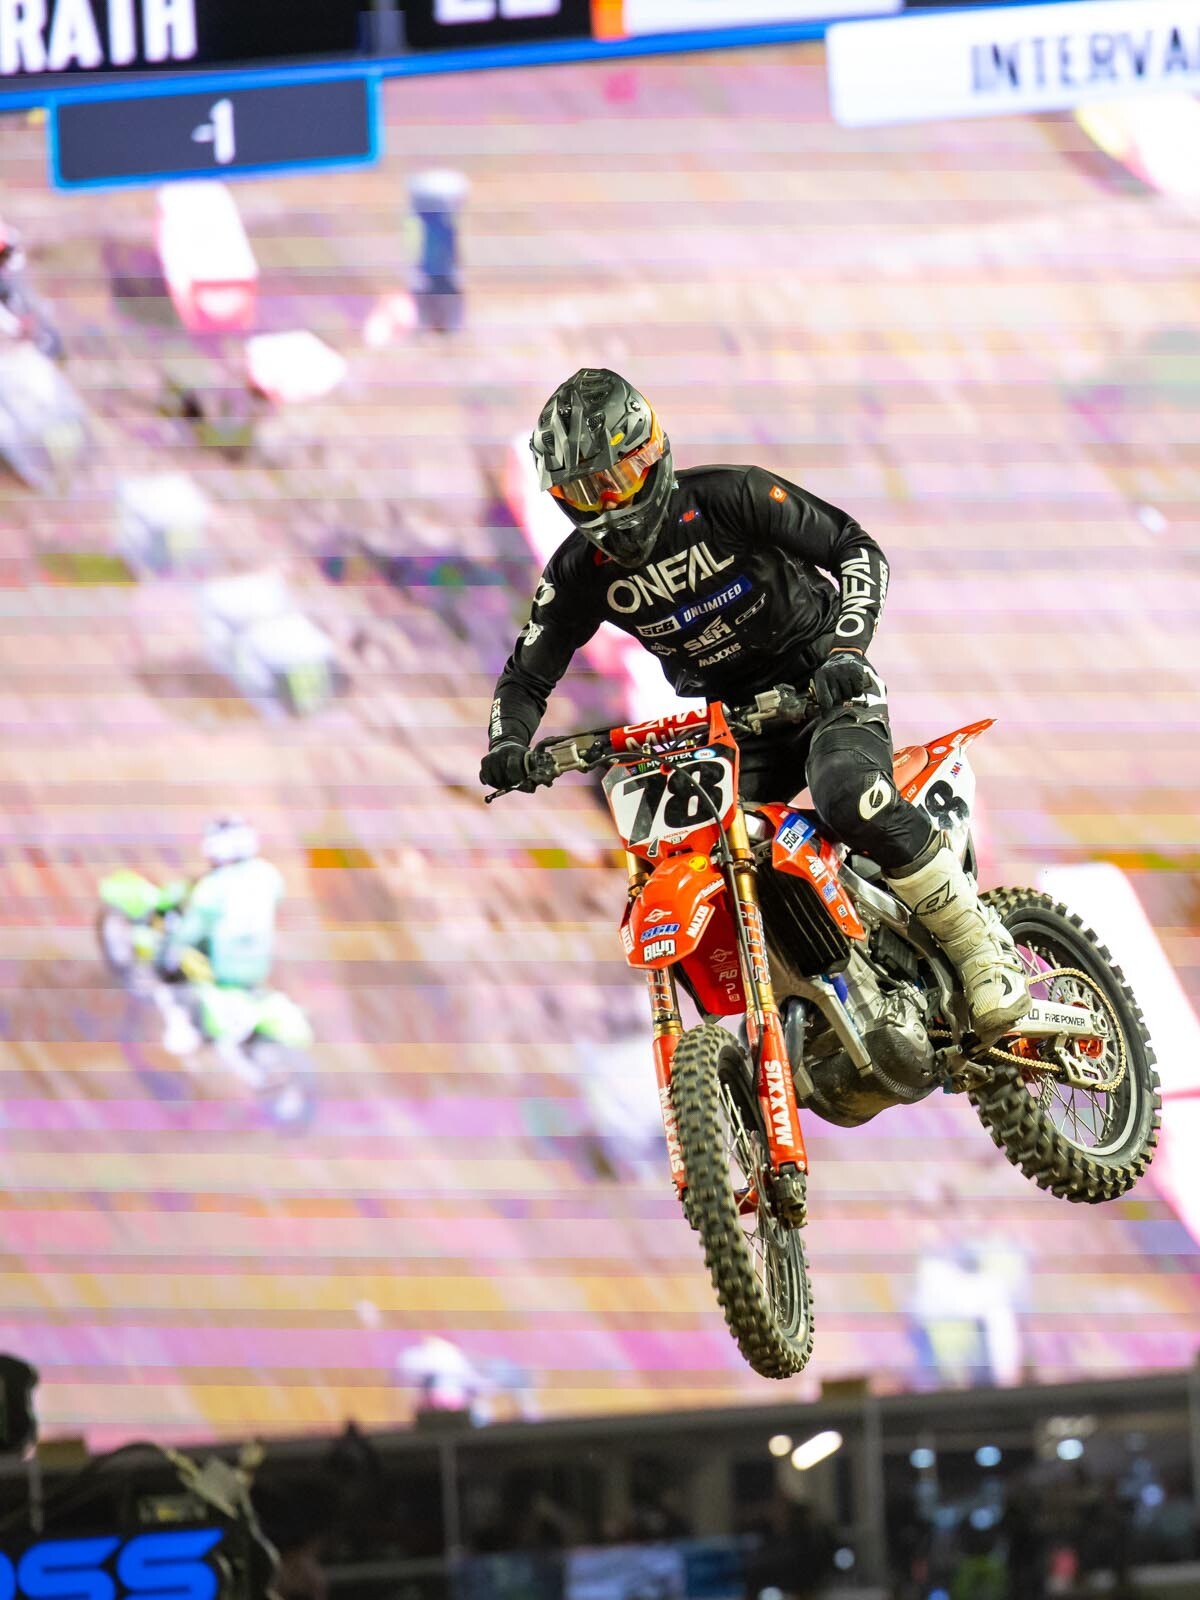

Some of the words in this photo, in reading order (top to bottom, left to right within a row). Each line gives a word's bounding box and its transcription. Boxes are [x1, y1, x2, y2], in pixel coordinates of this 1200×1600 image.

[683, 583, 742, 623] UNLIMITED
[698, 643, 742, 668] MAXXIS
[623, 761, 726, 846] 78
[686, 904, 710, 938] MAXXIS
[764, 1059, 794, 1147] MAXXIS
[0, 1526, 224, 1600] SS
